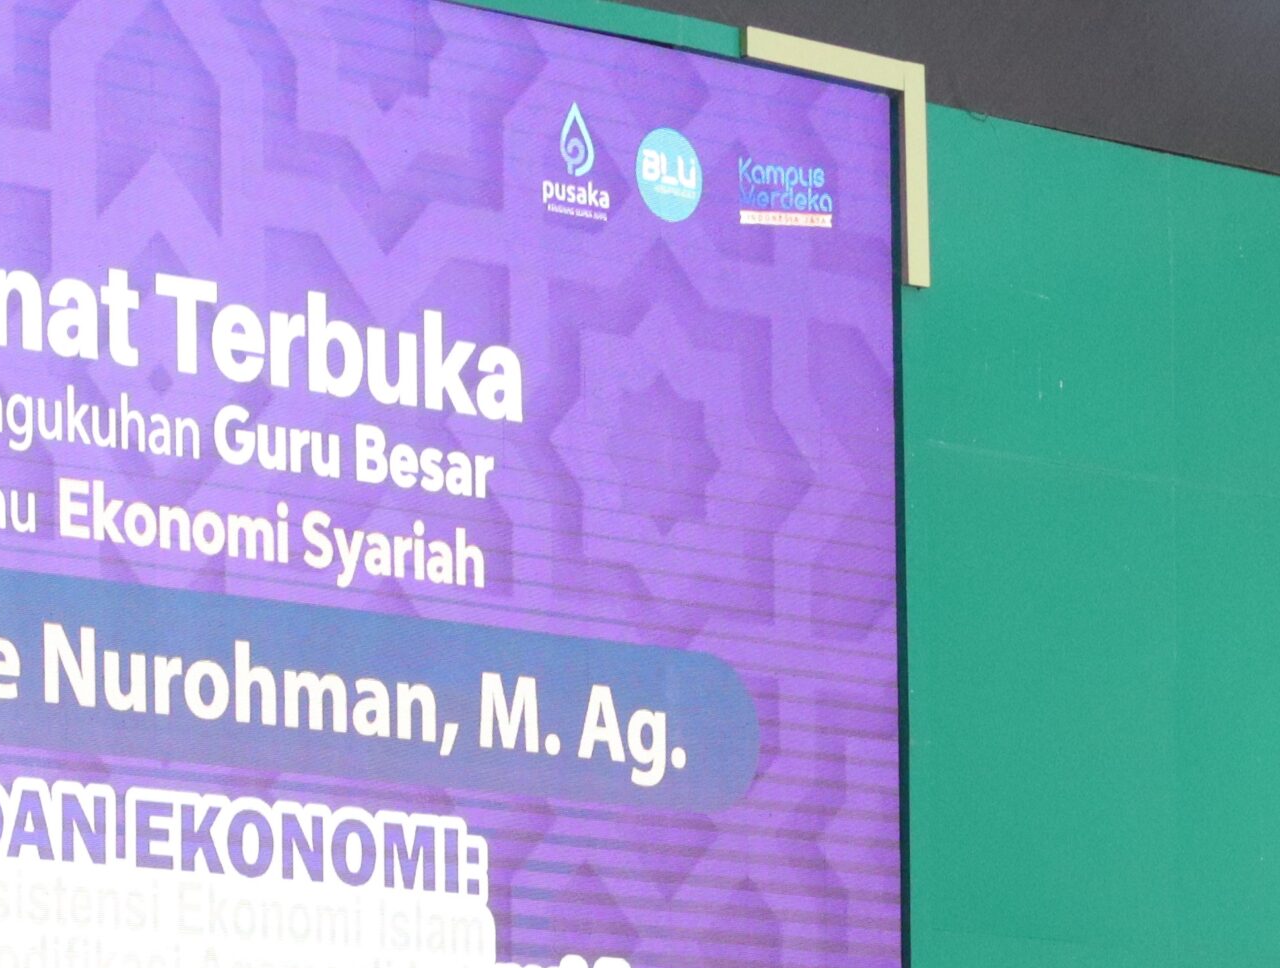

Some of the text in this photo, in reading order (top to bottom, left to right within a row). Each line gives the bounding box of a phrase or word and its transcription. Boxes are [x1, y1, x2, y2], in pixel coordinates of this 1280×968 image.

[542, 180, 610, 209] pusaka
[642, 149, 697, 189] BLU
[739, 157, 825, 192] Kampus
[740, 184, 833, 212] Merdeka
[156, 273, 523, 423] Terbuka
[214, 404, 340, 478] Guru
[355, 423, 494, 498] Besar
[59, 477, 289, 563] Ekonomi
[302, 509, 485, 588] Syariah
[43, 622, 459, 756] Nurohman,
[479, 672, 561, 755] M.
[578, 684, 687, 787] Ag.
[133, 798, 482, 896] EKONOMI:
[176, 882, 363, 948] Ekonomi
[378, 896, 486, 957] Islam
